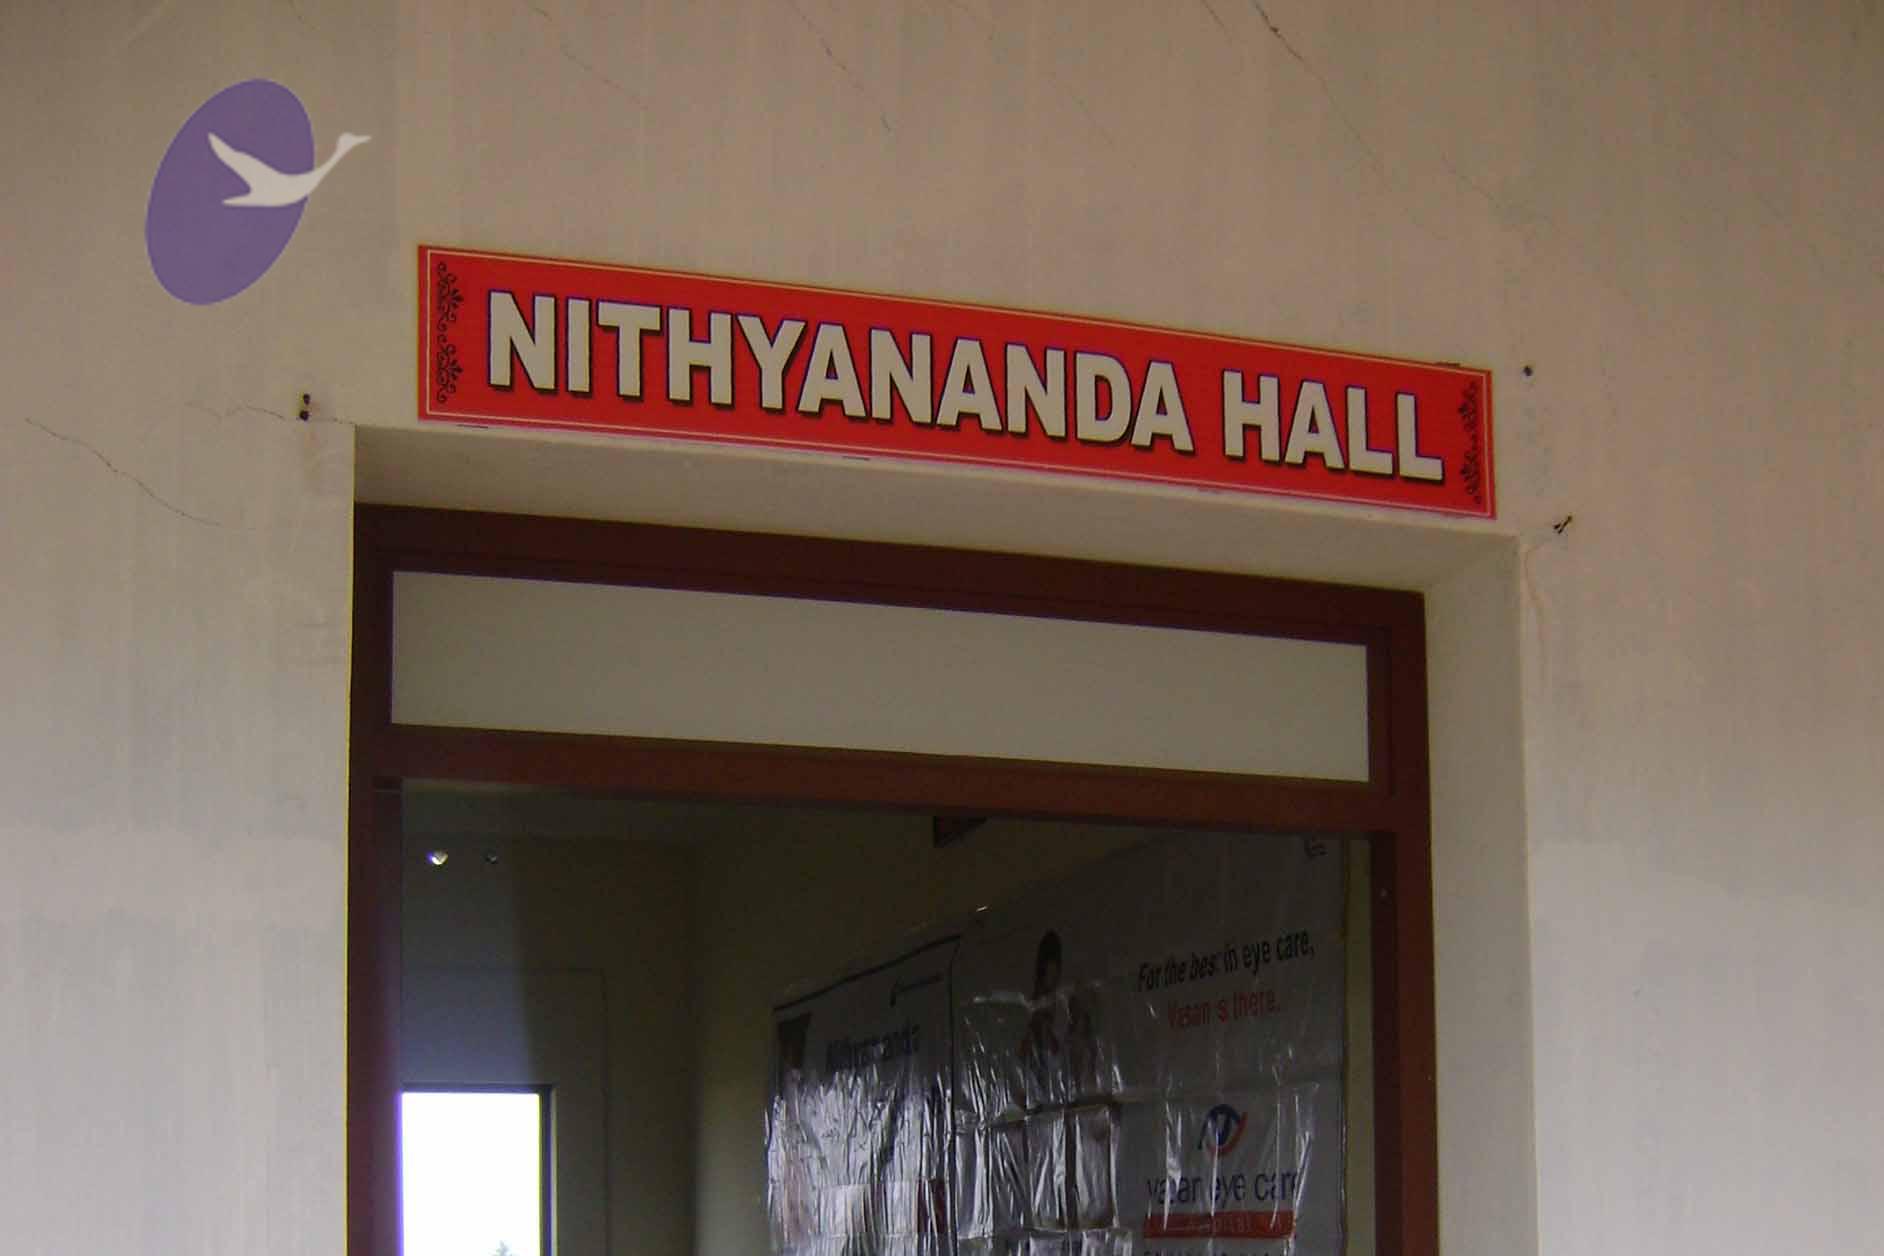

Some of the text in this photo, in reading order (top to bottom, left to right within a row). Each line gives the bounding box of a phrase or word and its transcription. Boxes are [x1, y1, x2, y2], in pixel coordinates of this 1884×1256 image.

[486, 290, 1444, 484] NITHYANANDA HALL
[1189, 950, 1219, 980] bes
[1242, 940, 1271, 975] eye
[1209, 1171, 1247, 1209] eye
